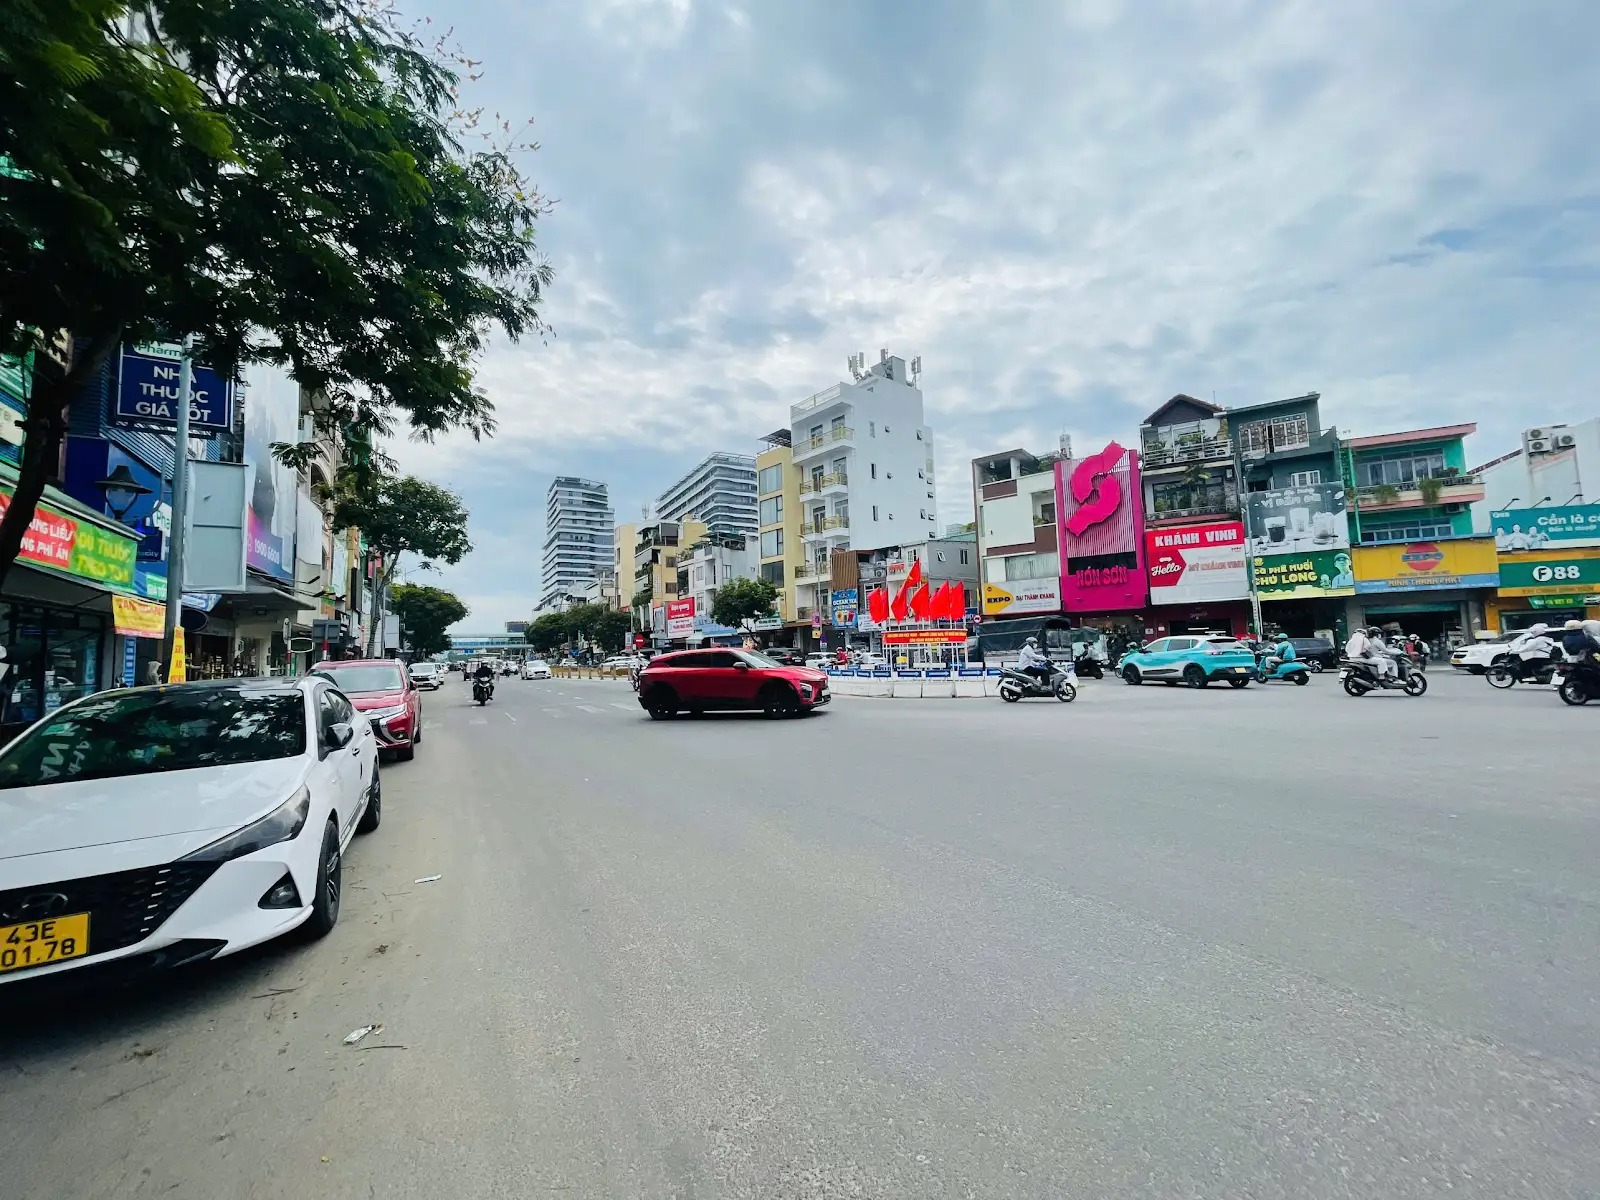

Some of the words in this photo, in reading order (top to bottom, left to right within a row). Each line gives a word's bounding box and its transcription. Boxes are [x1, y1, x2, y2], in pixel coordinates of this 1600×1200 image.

[135, 401, 171, 417] GIÁ
[1155, 532, 1200, 547] KHÁNH
[1205, 529, 1238, 542] VINH
[1151, 562, 1181, 576] Hello
[1282, 571, 1317, 584] LONG
[6, 920, 57, 945] 43E
